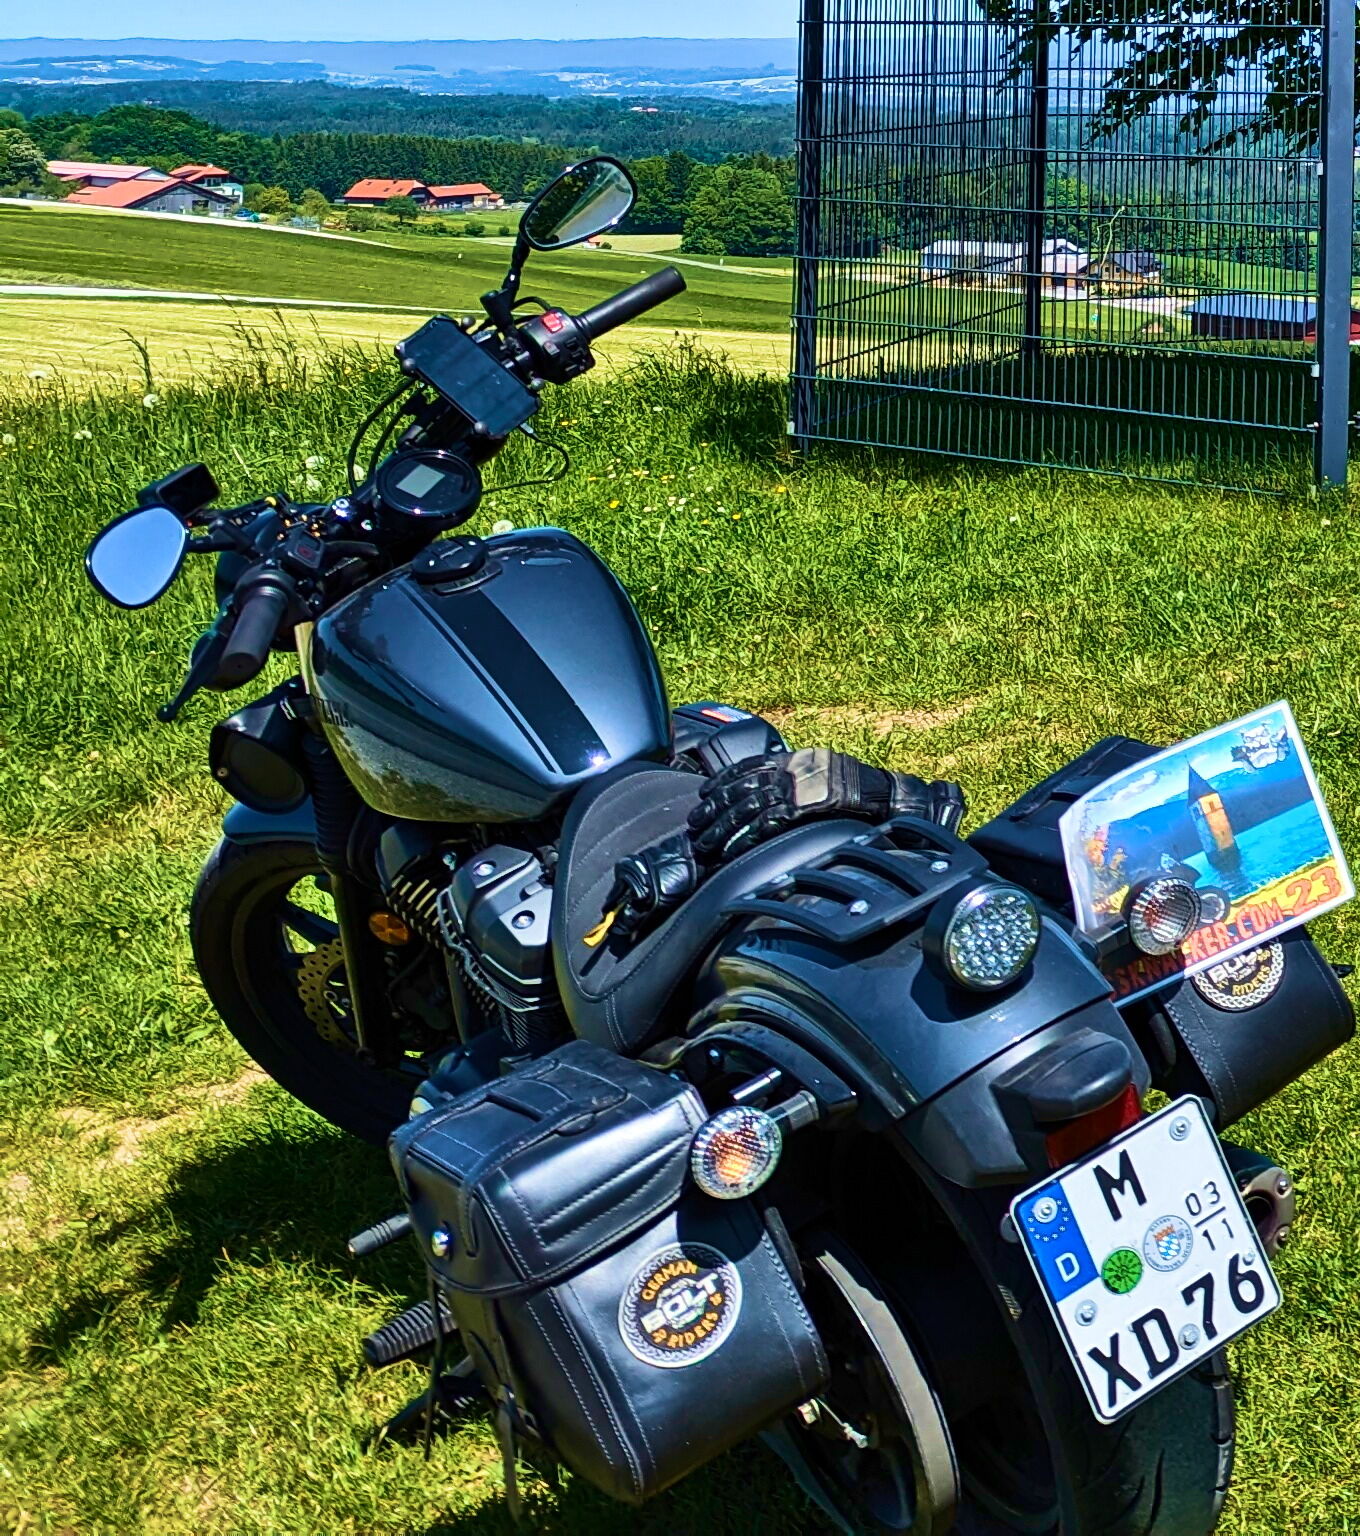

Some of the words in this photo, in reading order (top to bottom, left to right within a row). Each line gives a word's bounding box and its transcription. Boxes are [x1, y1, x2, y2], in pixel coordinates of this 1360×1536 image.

[1286, 865, 1342, 916] 23
[1231, 964, 1272, 996] RIDERS
[1093, 1148, 1147, 1221] M
[1184, 1181, 1222, 1217] 03
[1202, 1218, 1234, 1251] 11
[641, 1260, 698, 1300] GERMAN
[1054, 1251, 1081, 1283] D
[640, 1272, 719, 1334] BOLT
[667, 1312, 719, 1349] RIDERS
[1087, 1307, 1180, 1408] XD
[1181, 1252, 1265, 1341] 76
